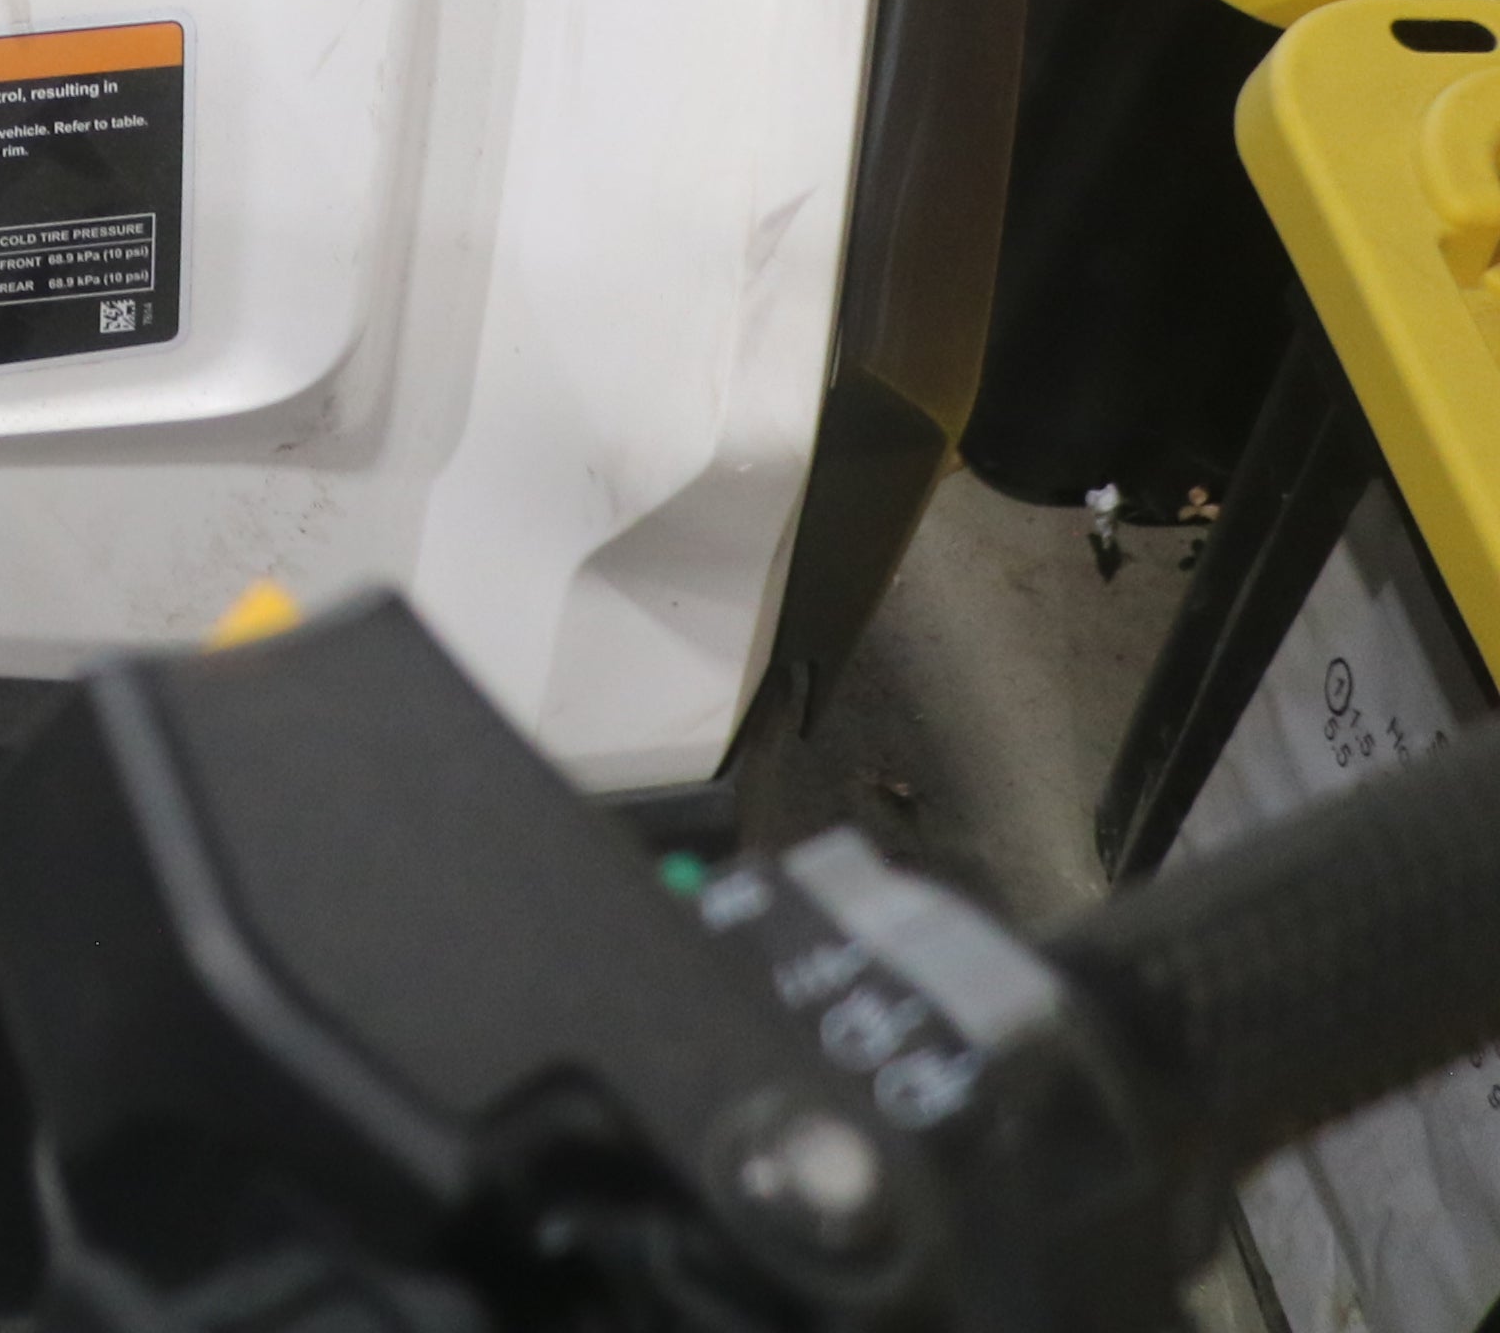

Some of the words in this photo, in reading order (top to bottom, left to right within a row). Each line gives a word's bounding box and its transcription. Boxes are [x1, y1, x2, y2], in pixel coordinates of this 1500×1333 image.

[30, 82, 100, 100] resulting
[103, 79, 118, 93] in
[53, 119, 91, 134] Refer
[93, 118, 108, 131] to
[110, 114, 148, 128] table.
[1, 144, 28, 157] rim.
[0, 233, 37, 247] COLD
[39, 229, 69, 242] TIRE
[72, 223, 143, 239] PRESSURE
